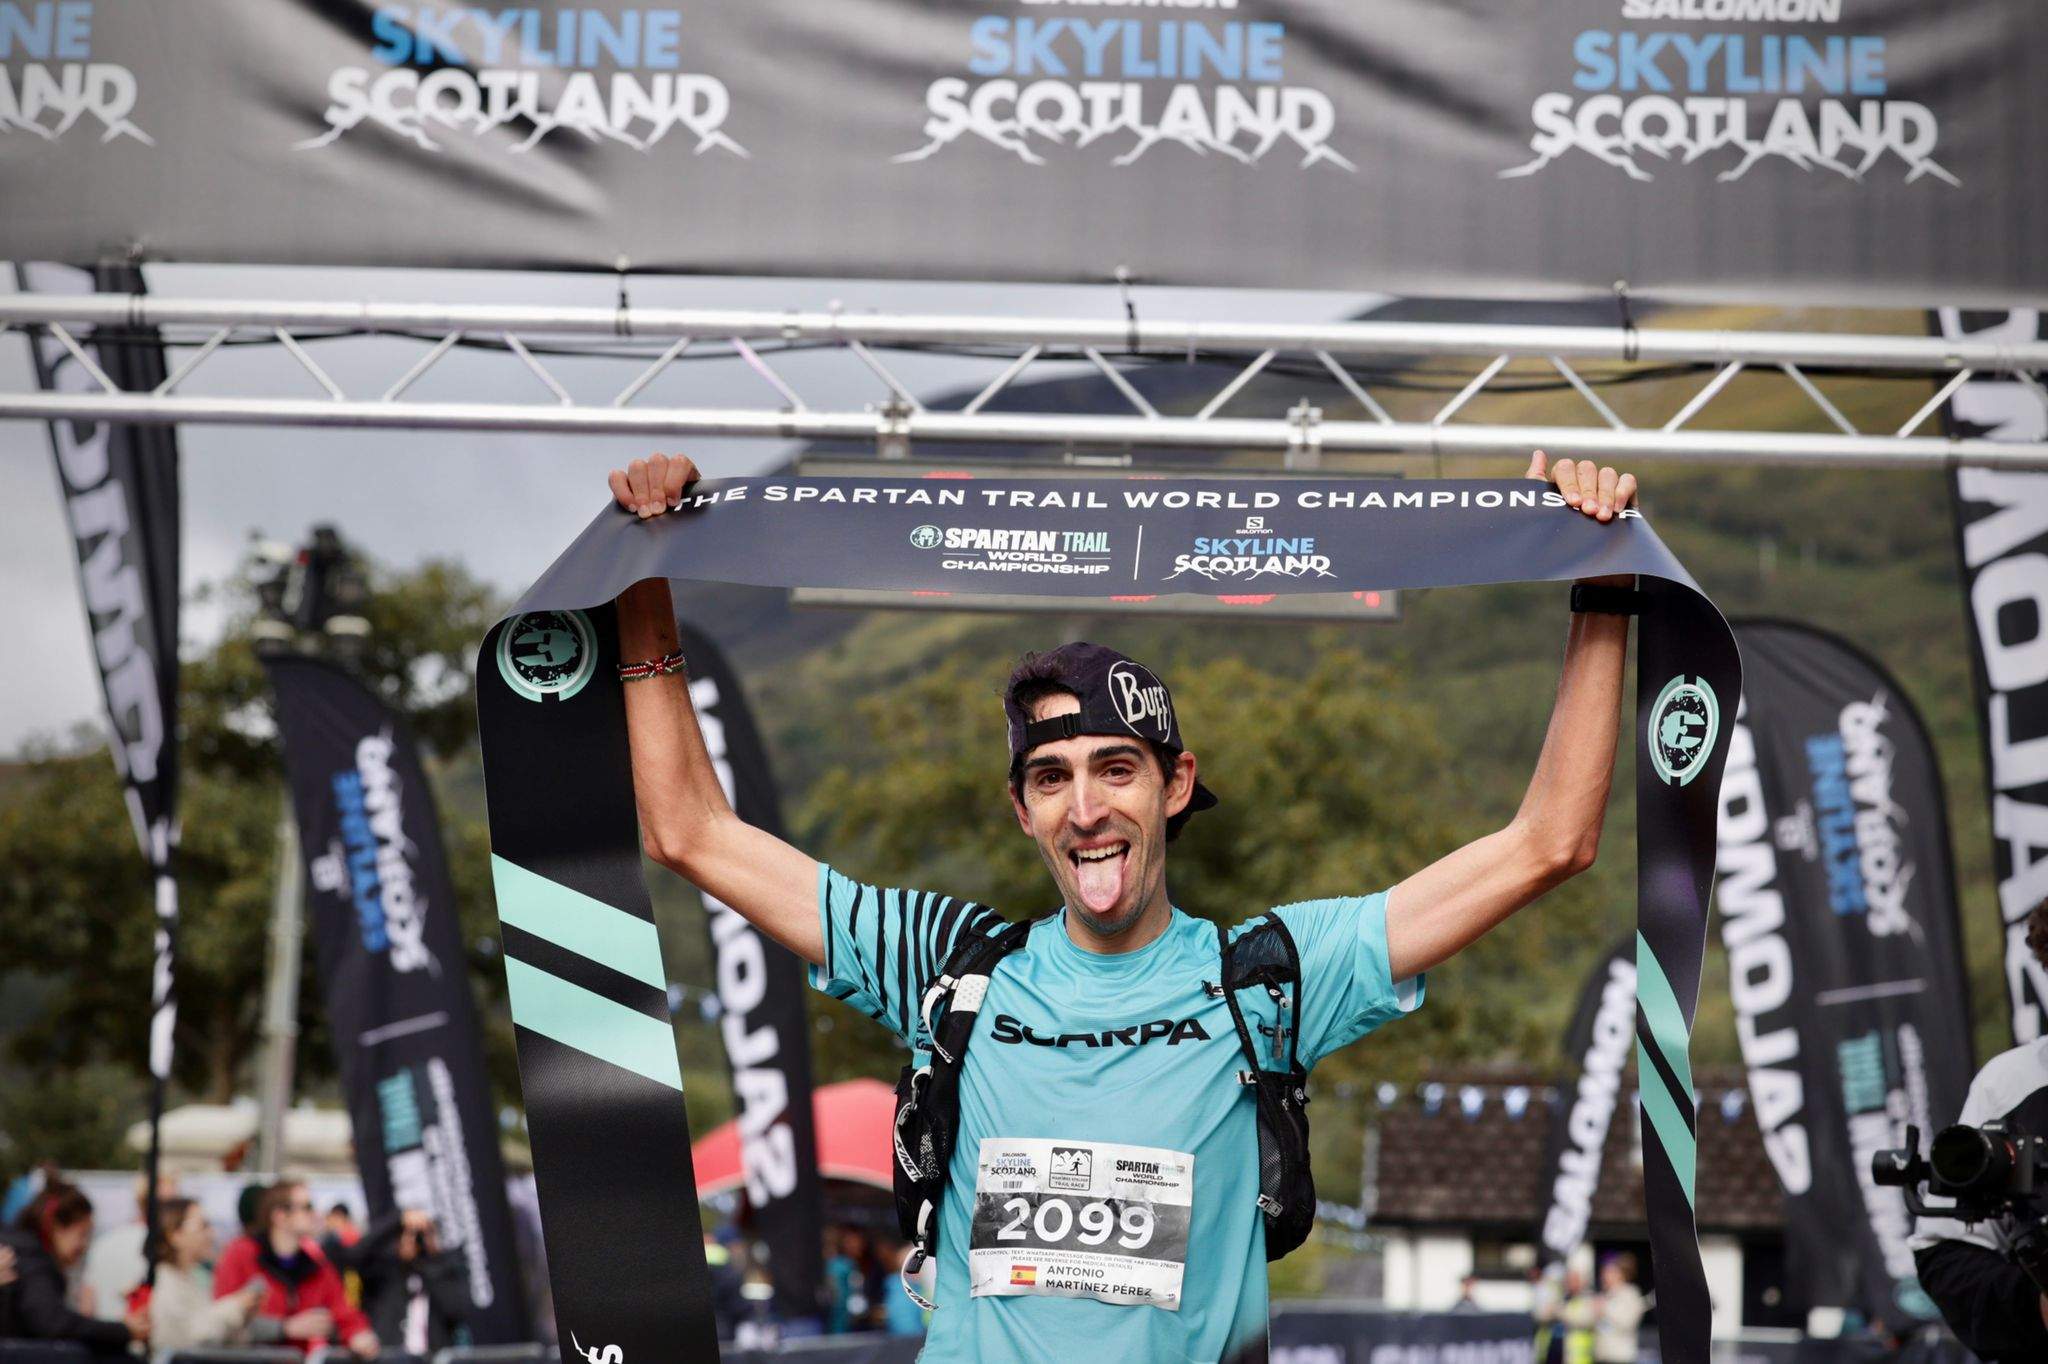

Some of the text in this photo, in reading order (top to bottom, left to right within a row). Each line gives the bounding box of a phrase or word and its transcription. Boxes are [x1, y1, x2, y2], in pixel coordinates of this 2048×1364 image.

[369, 8, 681, 67] SKYLINE
[969, 18, 1284, 80] SKYLINE
[1573, 30, 1888, 94] SKYLINE
[312, 66, 738, 142] SCOTLAND
[912, 79, 1346, 158] SCOTLAND
[1518, 93, 1950, 174] SCOTLAND
[674, 486, 748, 511] THE
[763, 485, 966, 506] SPARTAN
[981, 489, 1109, 509] TRAIL
[1123, 490, 1282, 509] WORLD
[944, 528, 1111, 552] SPARTAN TRAIL
[1194, 537, 1315, 555] SKYLINE
[942, 560, 1110, 575] CHAMPIONSHIP
[987, 551, 1068, 563] WORLD
[1169, 554, 1334, 577] SCOTLAND
[1839, 698, 1911, 938] SCOTLAND
[991, 1013, 1212, 1049] SCARPA
[991, 1167, 1037, 1177] SCOTLAND
[996, 1158, 1032, 1167] SKYLINE
[1116, 1160, 1159, 1174] SPARTAN
[1115, 1177, 1180, 1188] CHAMPIONSHIP
[1132, 1173, 1163, 1181] WORLD
[997, 1197, 1155, 1250] 2099
[1047, 1265, 1104, 1279] ANTONIO
[1045, 1278, 1152, 1297] MARTÍNEZ PÉREZ
